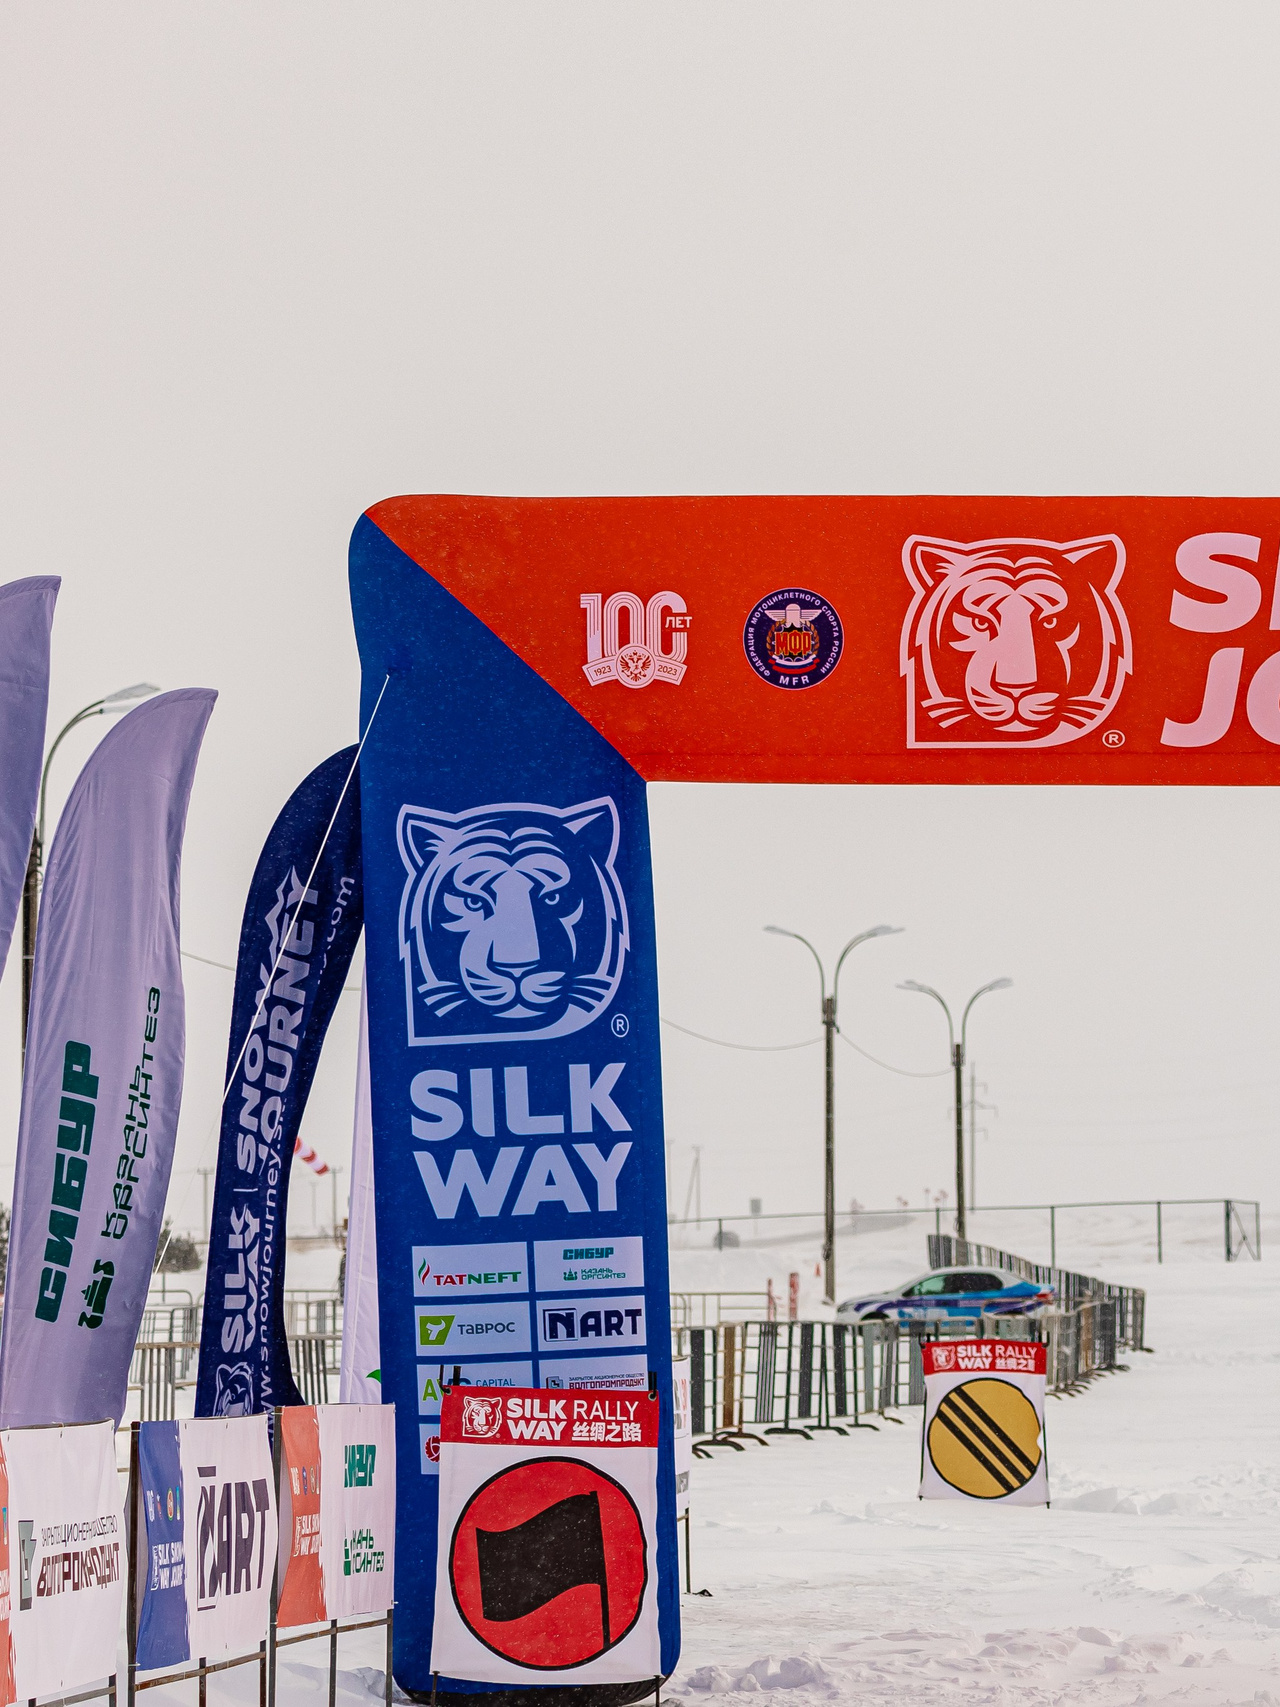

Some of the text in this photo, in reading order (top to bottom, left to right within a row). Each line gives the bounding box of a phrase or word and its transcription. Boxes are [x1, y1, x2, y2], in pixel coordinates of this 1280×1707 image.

[580, 588, 688, 664] 100
[664, 616, 693, 629] ЛЕТ
[821, 605, 840, 638] СПОРТА
[747, 627, 771, 677] ФЕДЕРАЦИЯ
[775, 629, 812, 656] МФР
[820, 640, 840, 674] РОССИИ
[593, 665, 613, 677] 1923
[657, 665, 678, 676] 2023
[778, 675, 810, 686] MFR
[257, 865, 319, 1177] JOURNEY
[236, 962, 271, 1175] SNOW
[113, 986, 161, 1240] ОРГСИНТЕЗ
[410, 1063, 632, 1141] SILK
[100, 1064, 141, 1238] КАЗАНЬ
[35, 1040, 100, 1323] СИБУР
[413, 1142, 633, 1219] WAY
[563, 1247, 615, 1260] СИБУР
[221, 1204, 248, 1353] SILK
[244, 1207, 260, 1351] WAY
[433, 1271, 522, 1286] TATNEFT
[581, 1267, 613, 1275] КАЗАНЬ
[581, 1273, 627, 1281] ОРГСИНТЕЗ
[546, 1307, 643, 1341] NART
[957, 1345, 1037, 1359] SILK RALLY
[957, 1357, 993, 1370] WAY
[506, 1398, 639, 1421] SILK RALLY
[507, 1420, 567, 1441] WAY
[571, 1422, 642, 1442] 丝绸之路
[197, 1477, 270, 1600] NART
